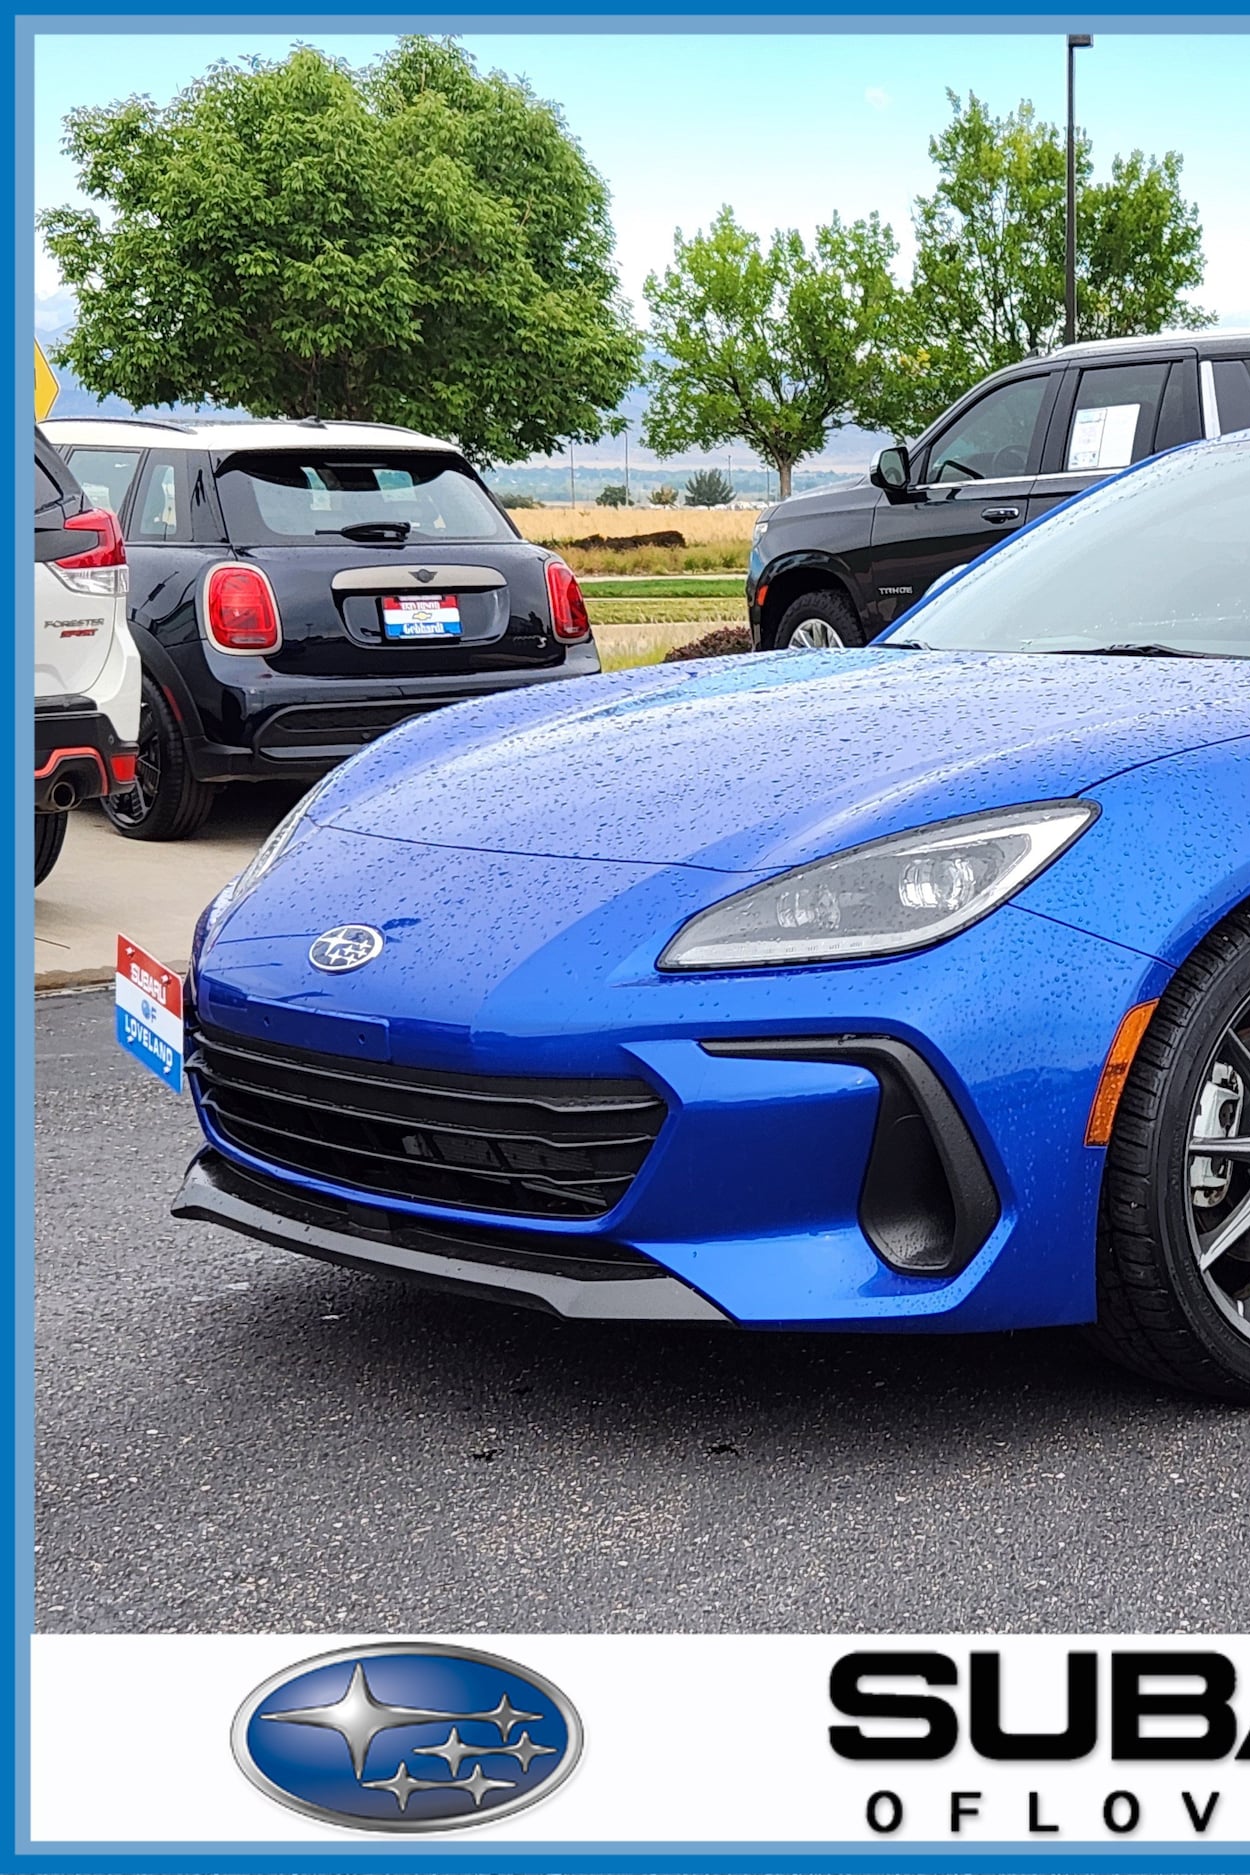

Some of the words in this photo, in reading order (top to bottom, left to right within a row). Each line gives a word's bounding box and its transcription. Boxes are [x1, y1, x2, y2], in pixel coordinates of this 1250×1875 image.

[43, 618, 105, 628] FORESTER
[129, 962, 167, 1005] SUBARU
[124, 1013, 174, 1068] LOVELAND
